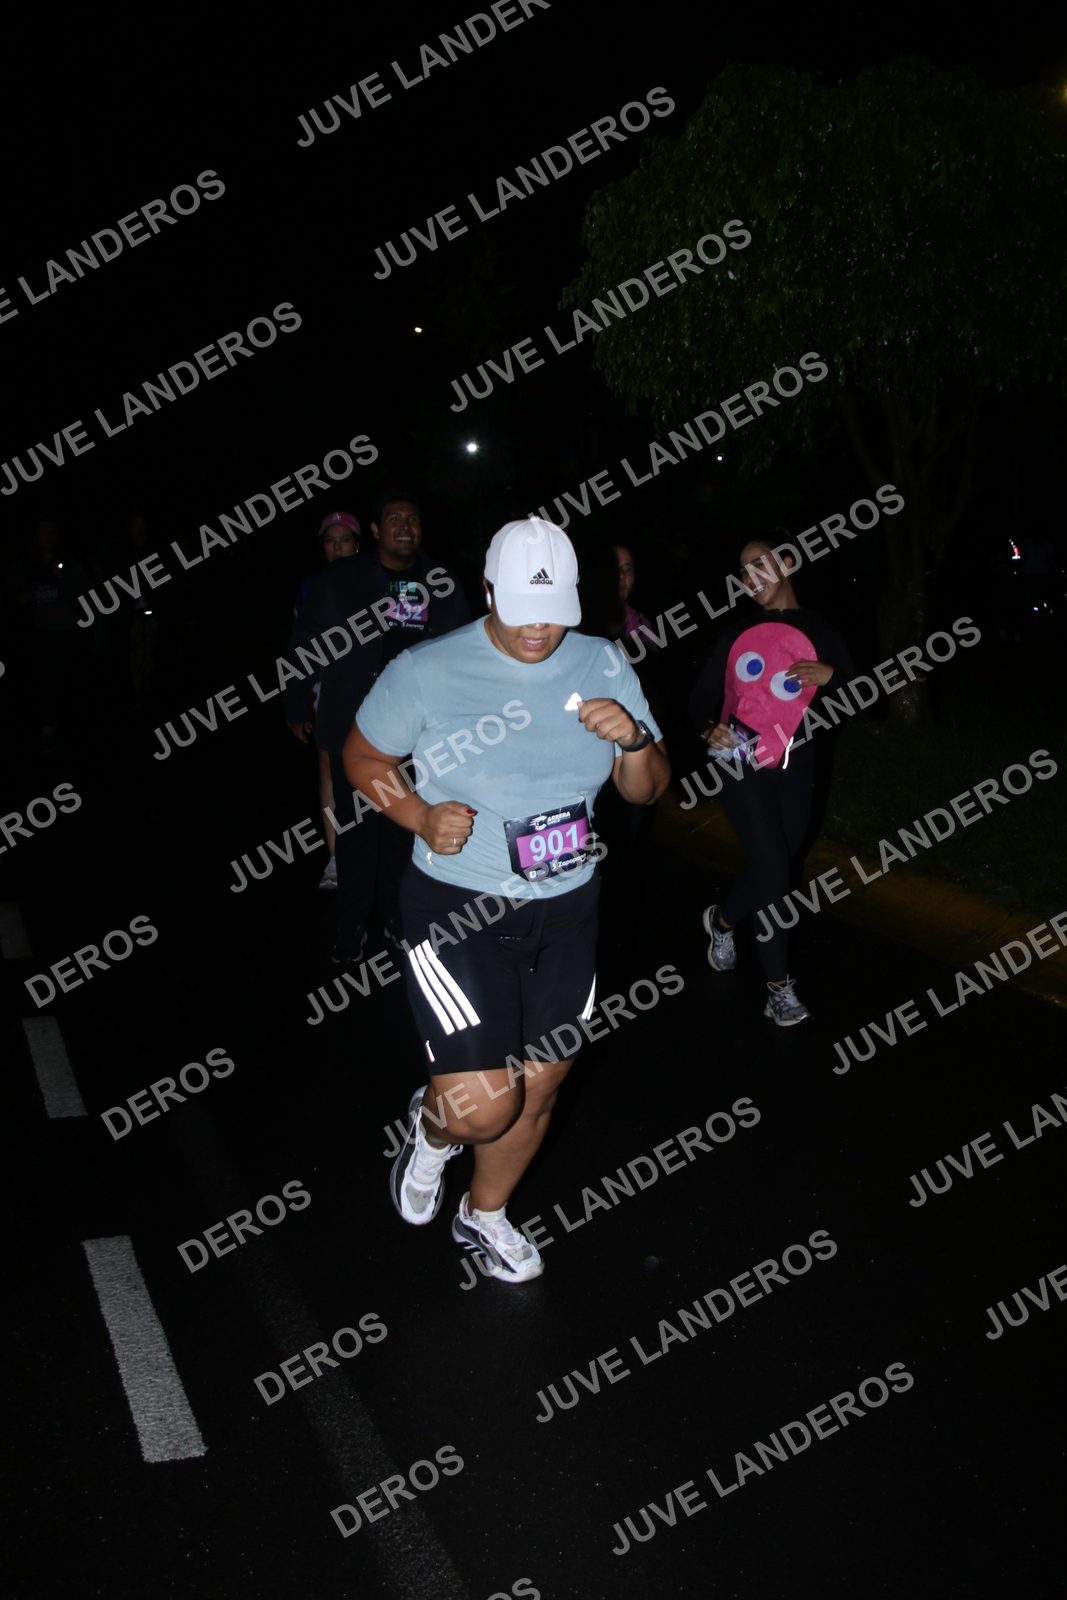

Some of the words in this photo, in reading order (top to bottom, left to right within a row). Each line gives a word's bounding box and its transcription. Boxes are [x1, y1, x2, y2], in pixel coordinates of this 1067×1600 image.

[529, 577, 553, 586] adidas
[393, 603, 422, 620] 132
[529, 823, 579, 862] 901
